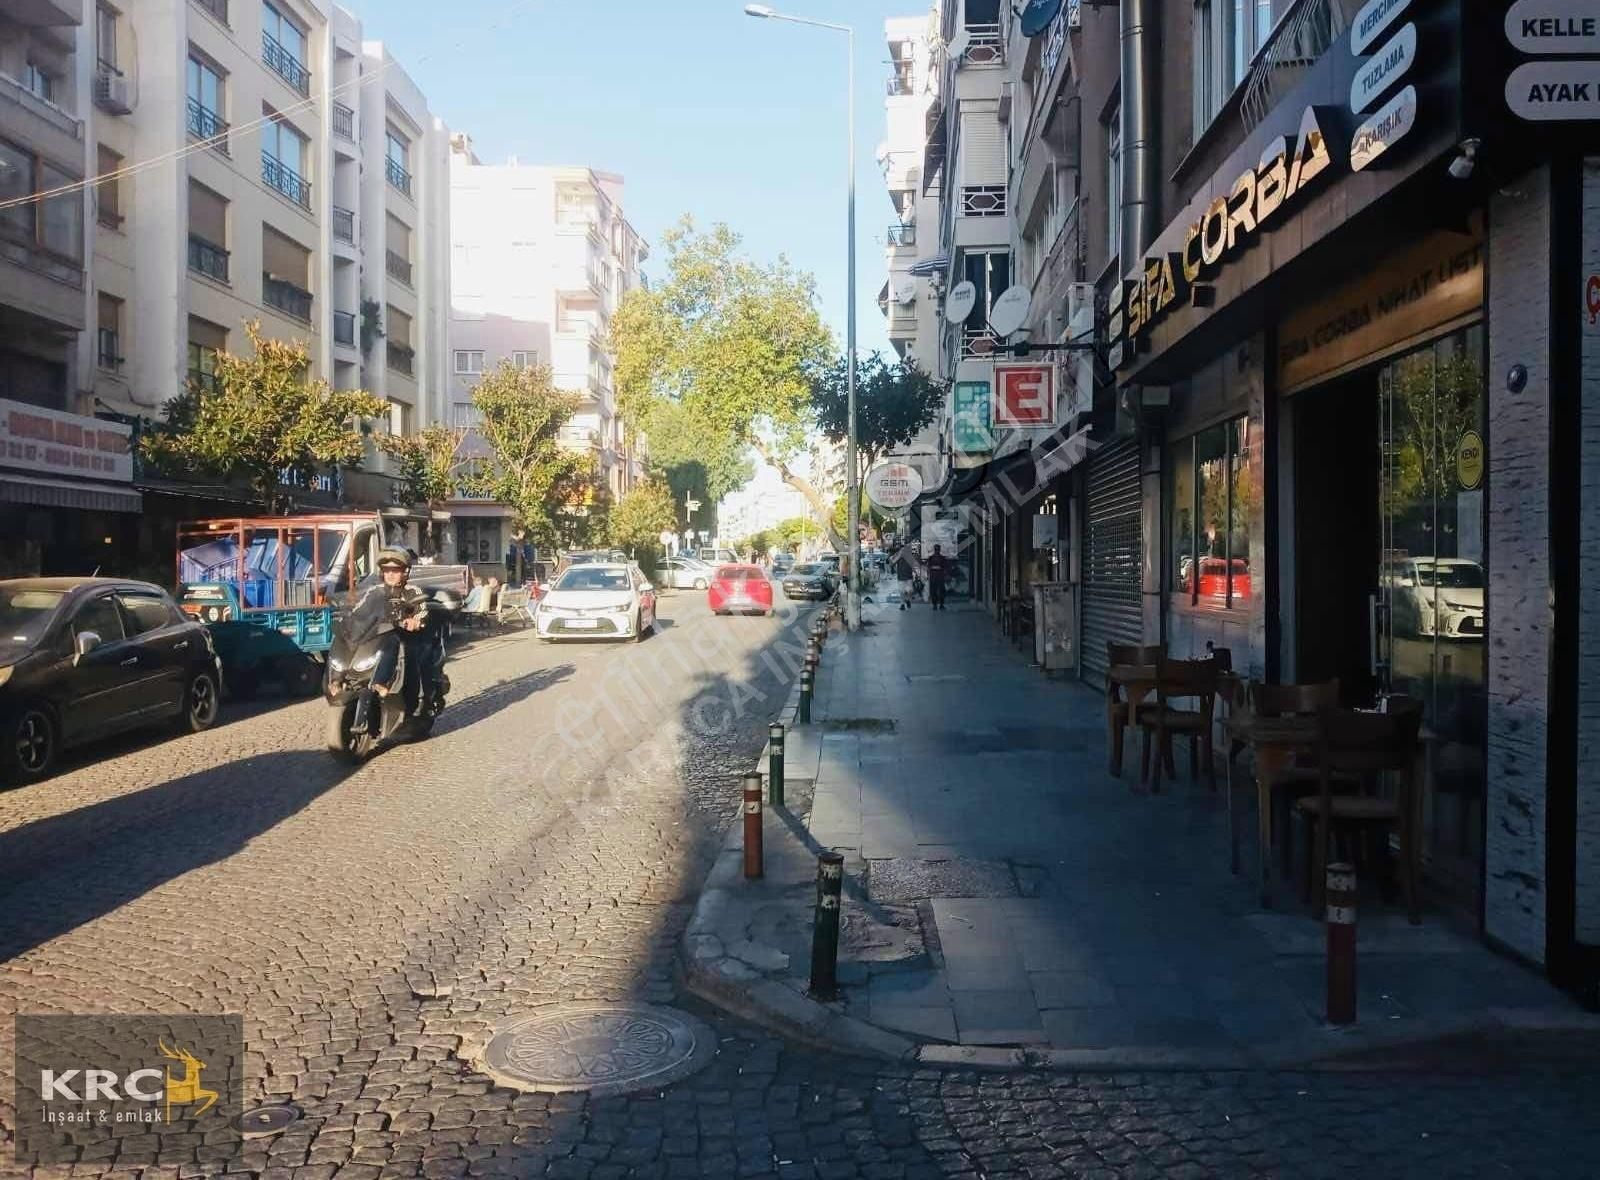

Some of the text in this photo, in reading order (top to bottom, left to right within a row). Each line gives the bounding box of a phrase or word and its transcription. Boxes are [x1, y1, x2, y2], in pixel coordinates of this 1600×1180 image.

[1522, 18, 1596, 37] KELLE
[1363, 44, 1404, 94] TUZLAMA
[1528, 83, 1590, 102] AYAK
